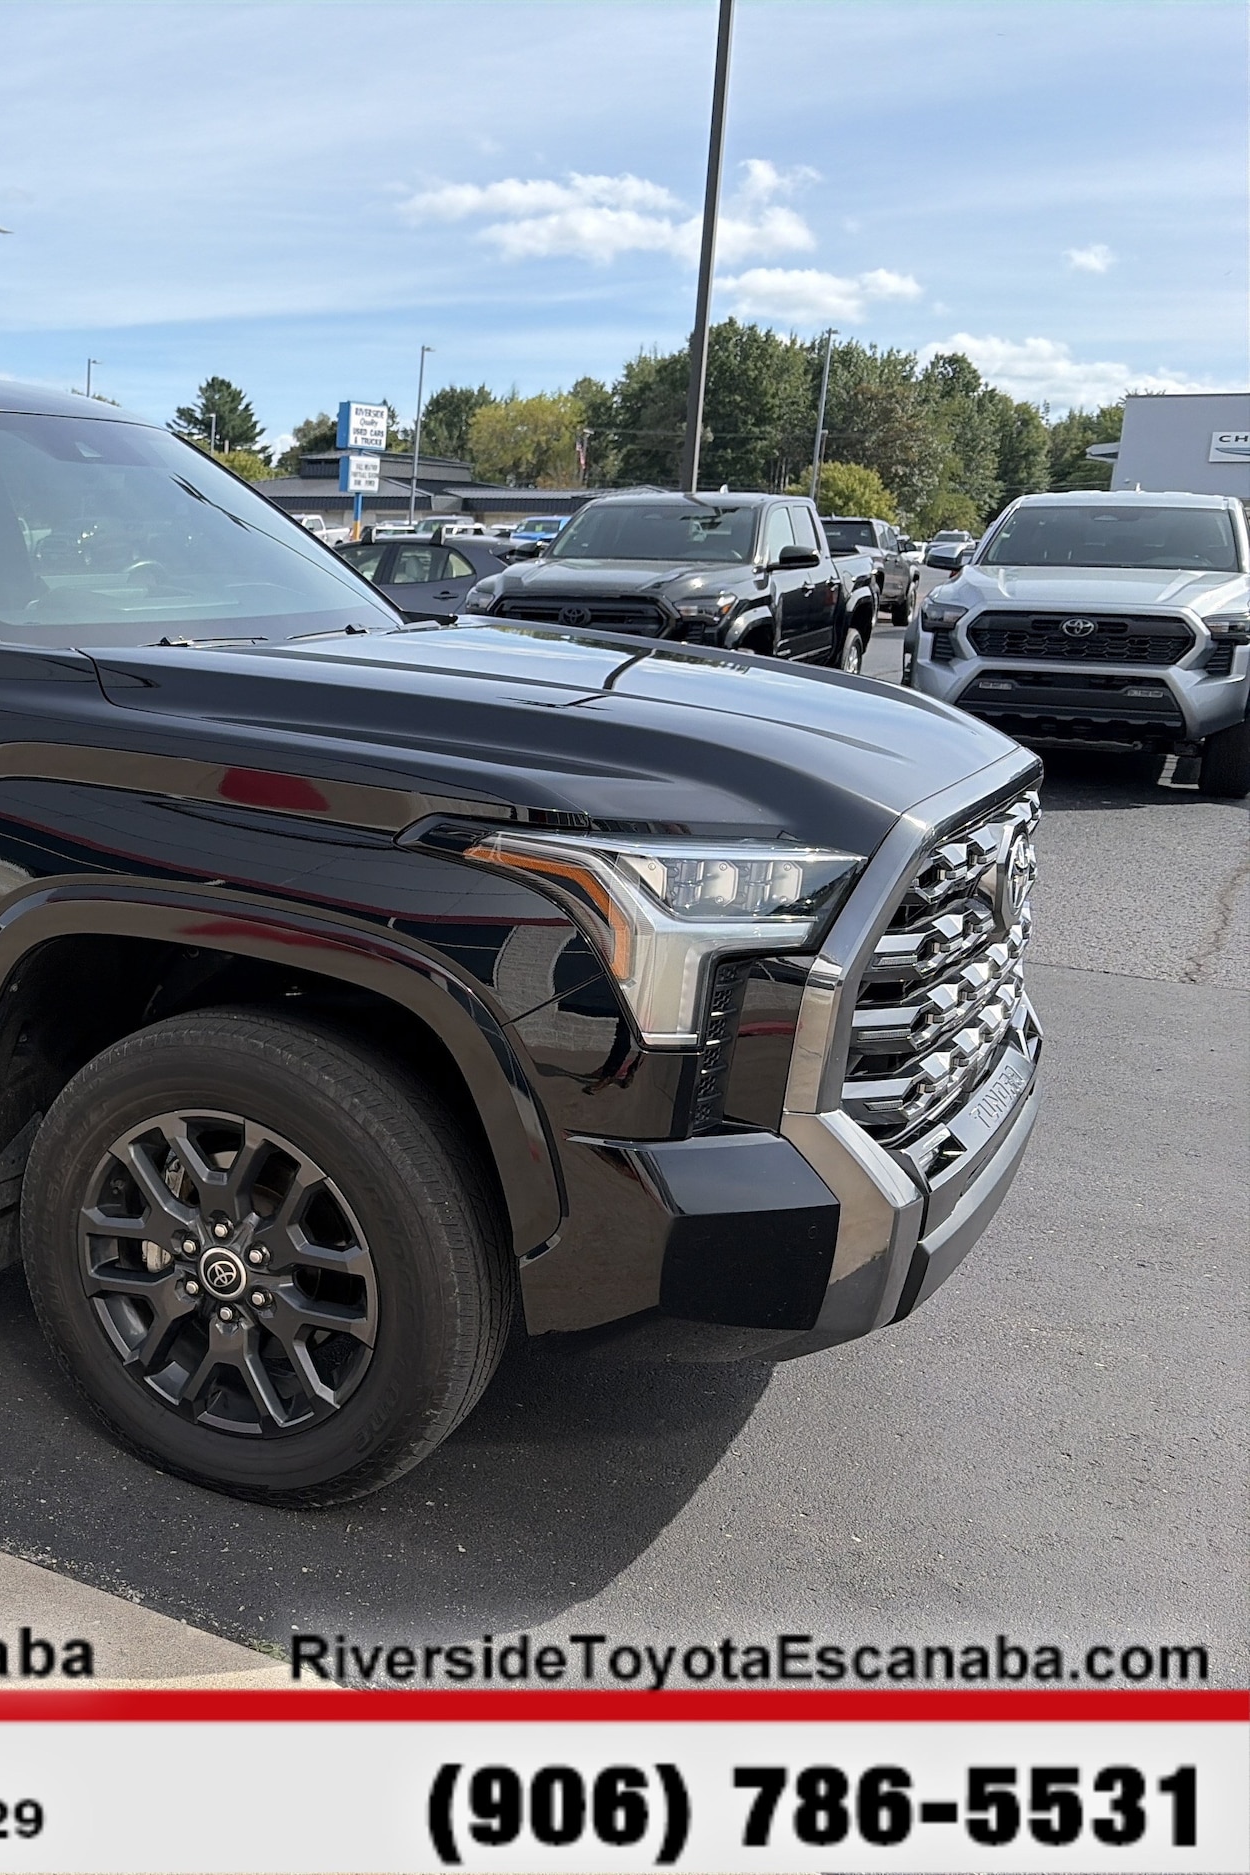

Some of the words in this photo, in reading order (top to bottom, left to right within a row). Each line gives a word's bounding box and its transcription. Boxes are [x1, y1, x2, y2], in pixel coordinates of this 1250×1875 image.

[354, 407, 385, 419] RIVERSIDE
[353, 427, 368, 436] USED
[369, 429, 384, 438] CARS
[361, 437, 382, 447] TRUCKS
[969, 1064, 1026, 1129] TUNDRA
